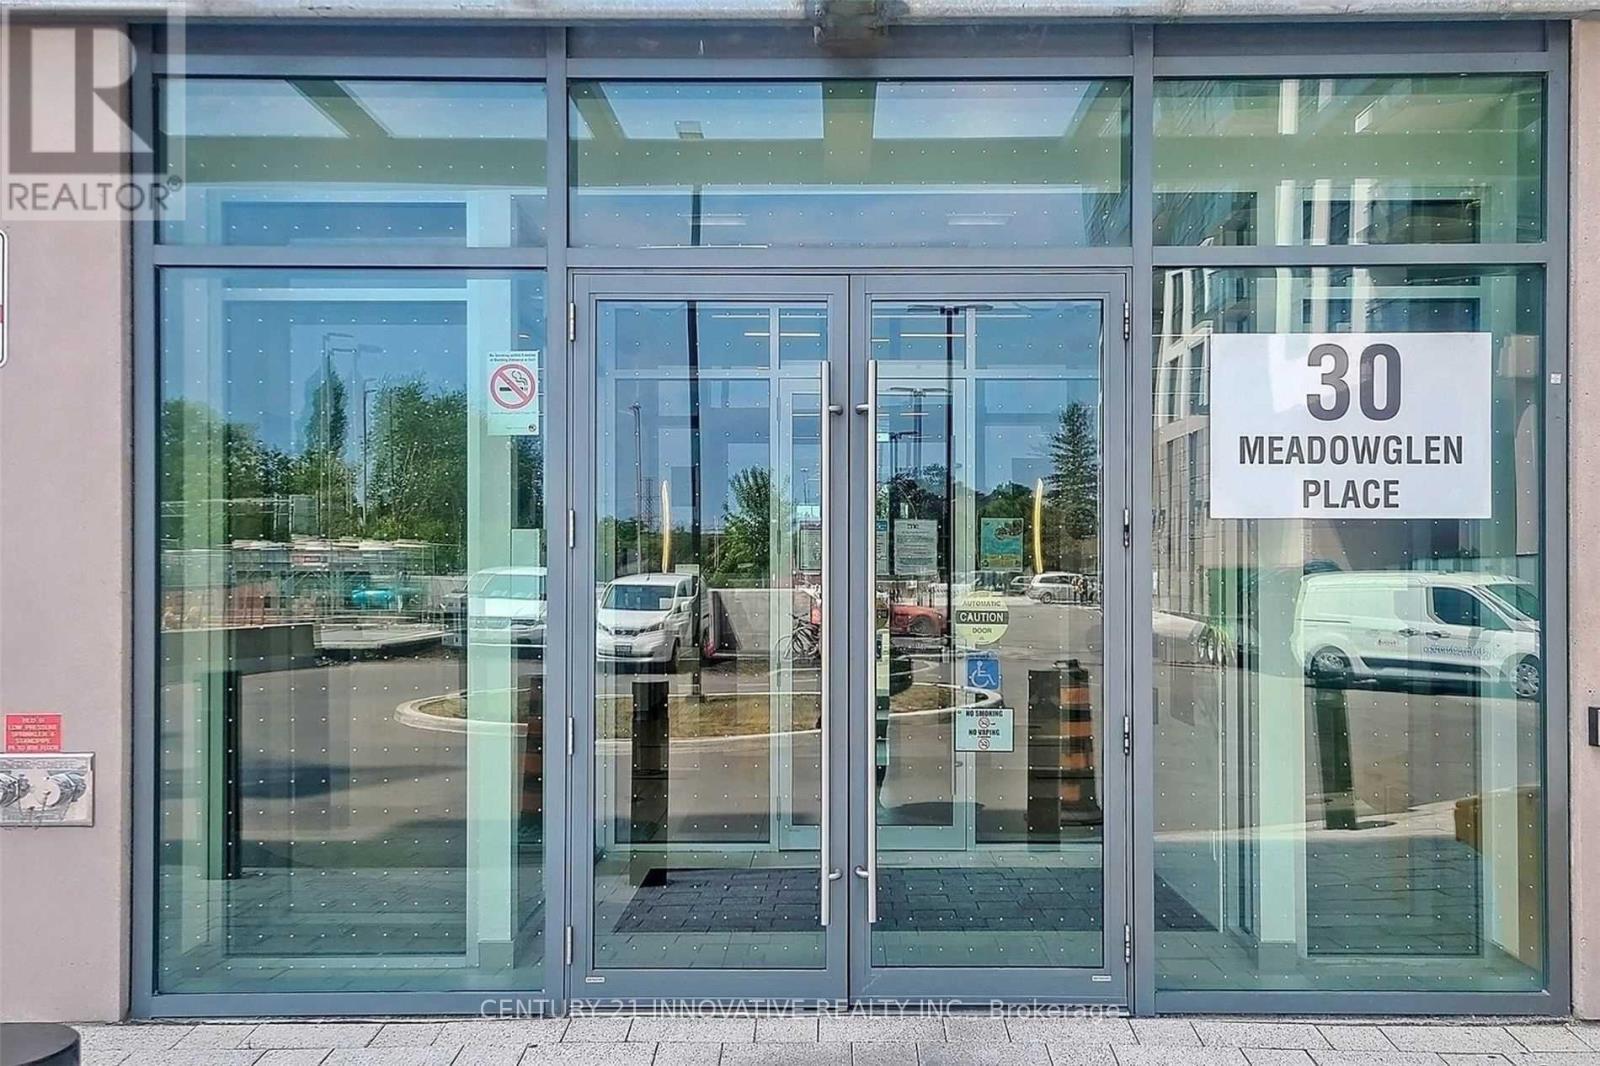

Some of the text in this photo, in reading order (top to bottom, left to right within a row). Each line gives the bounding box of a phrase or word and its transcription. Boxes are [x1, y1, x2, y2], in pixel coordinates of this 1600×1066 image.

[1306, 343, 1402, 421] 30
[1239, 435, 1463, 465] MEADOWGLEN
[1303, 480, 1400, 509] PLACE
[959, 612, 1004, 622] CAUTION
